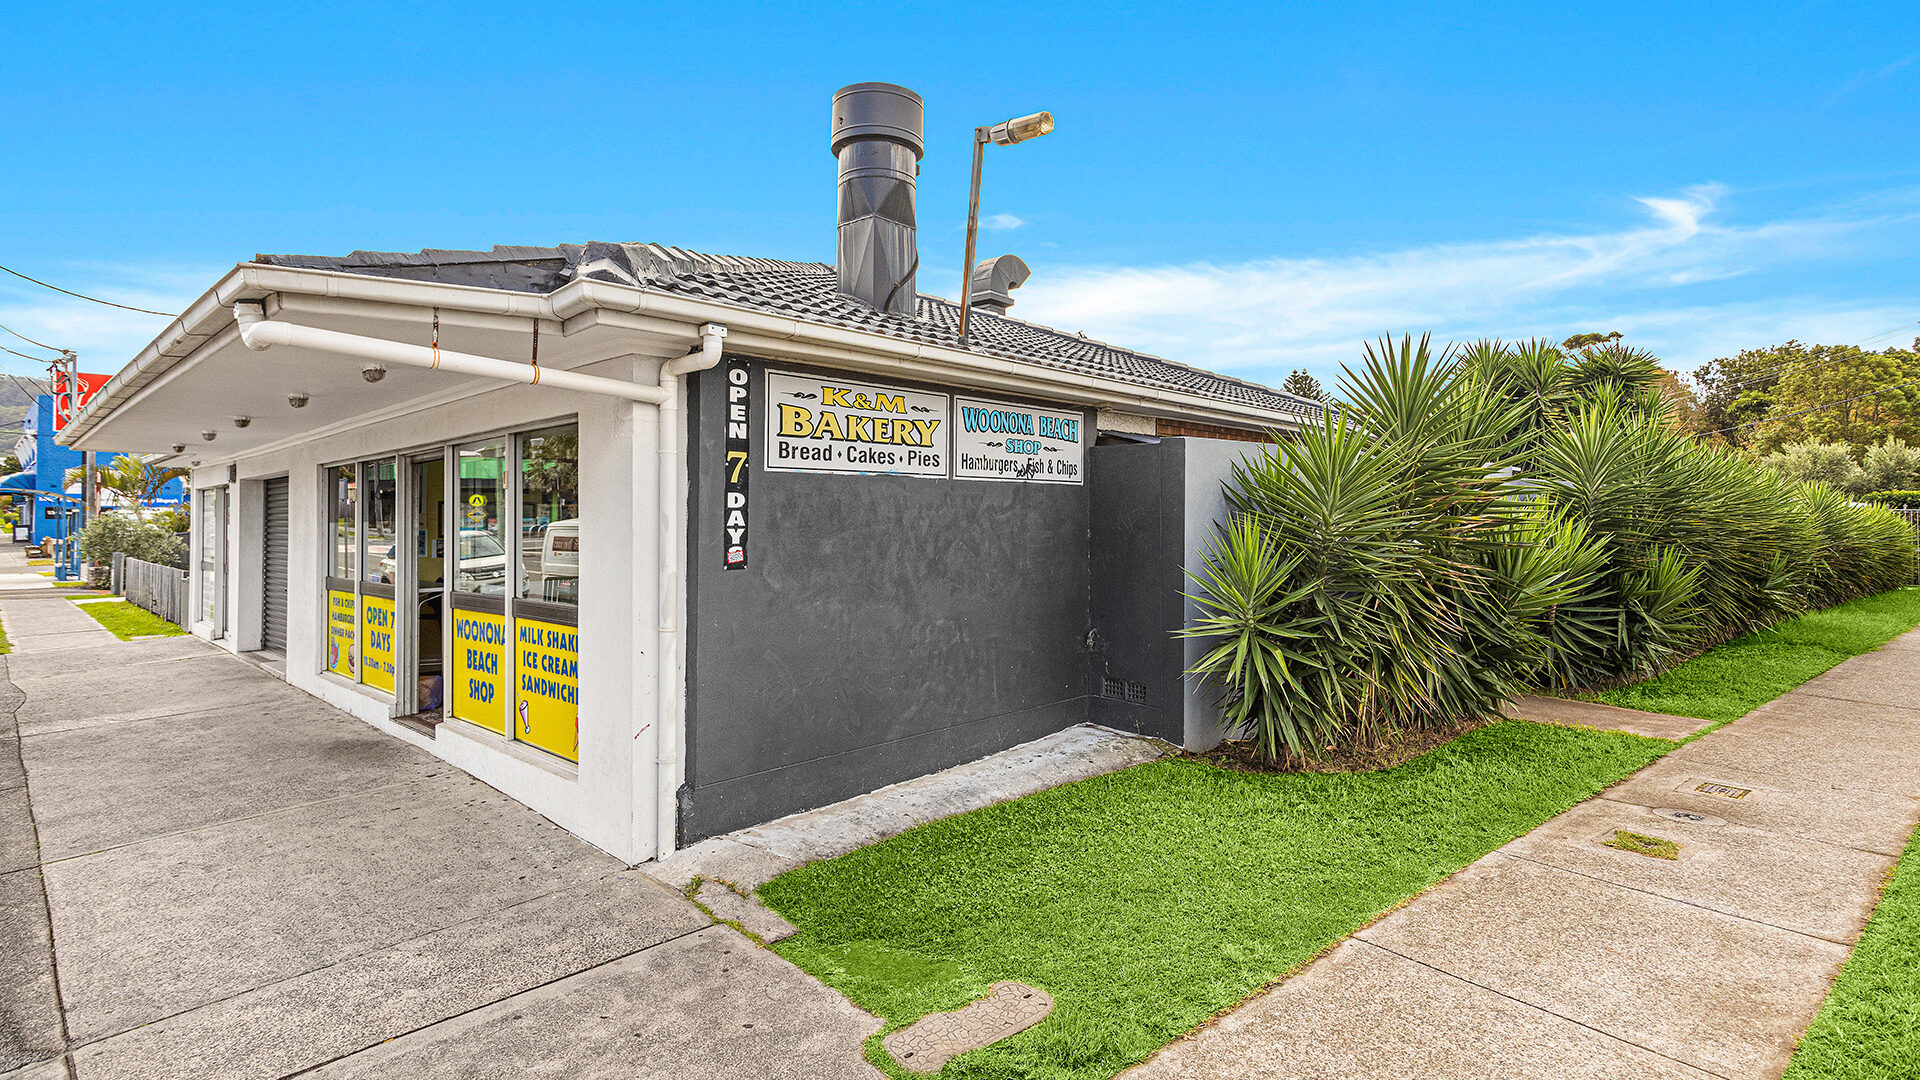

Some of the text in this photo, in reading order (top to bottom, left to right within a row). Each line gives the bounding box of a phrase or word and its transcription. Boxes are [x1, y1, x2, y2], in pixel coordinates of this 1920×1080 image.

[728, 368, 748, 439] OPEN
[821, 385, 908, 414] K&M
[777, 402, 941, 448] BAKERY
[961, 406, 1079, 443] WOONONA BEACH
[778, 441, 940, 467] Bread Cakes Pies
[1005, 438, 1042, 455] SHOP
[727, 451, 748, 484] 7
[1047, 459, 1054, 474] &
[1056, 459, 1078, 478] Chips
[344, 599, 355, 608] CHIP
[366, 606, 395, 629] OPEN 7
[370, 630, 391, 653] DAYS
[519, 625, 544, 647] MILK
[466, 648, 498, 675] BEACH
[523, 650, 579, 680] ICE CREAM
[469, 678, 494, 704] SHOP
